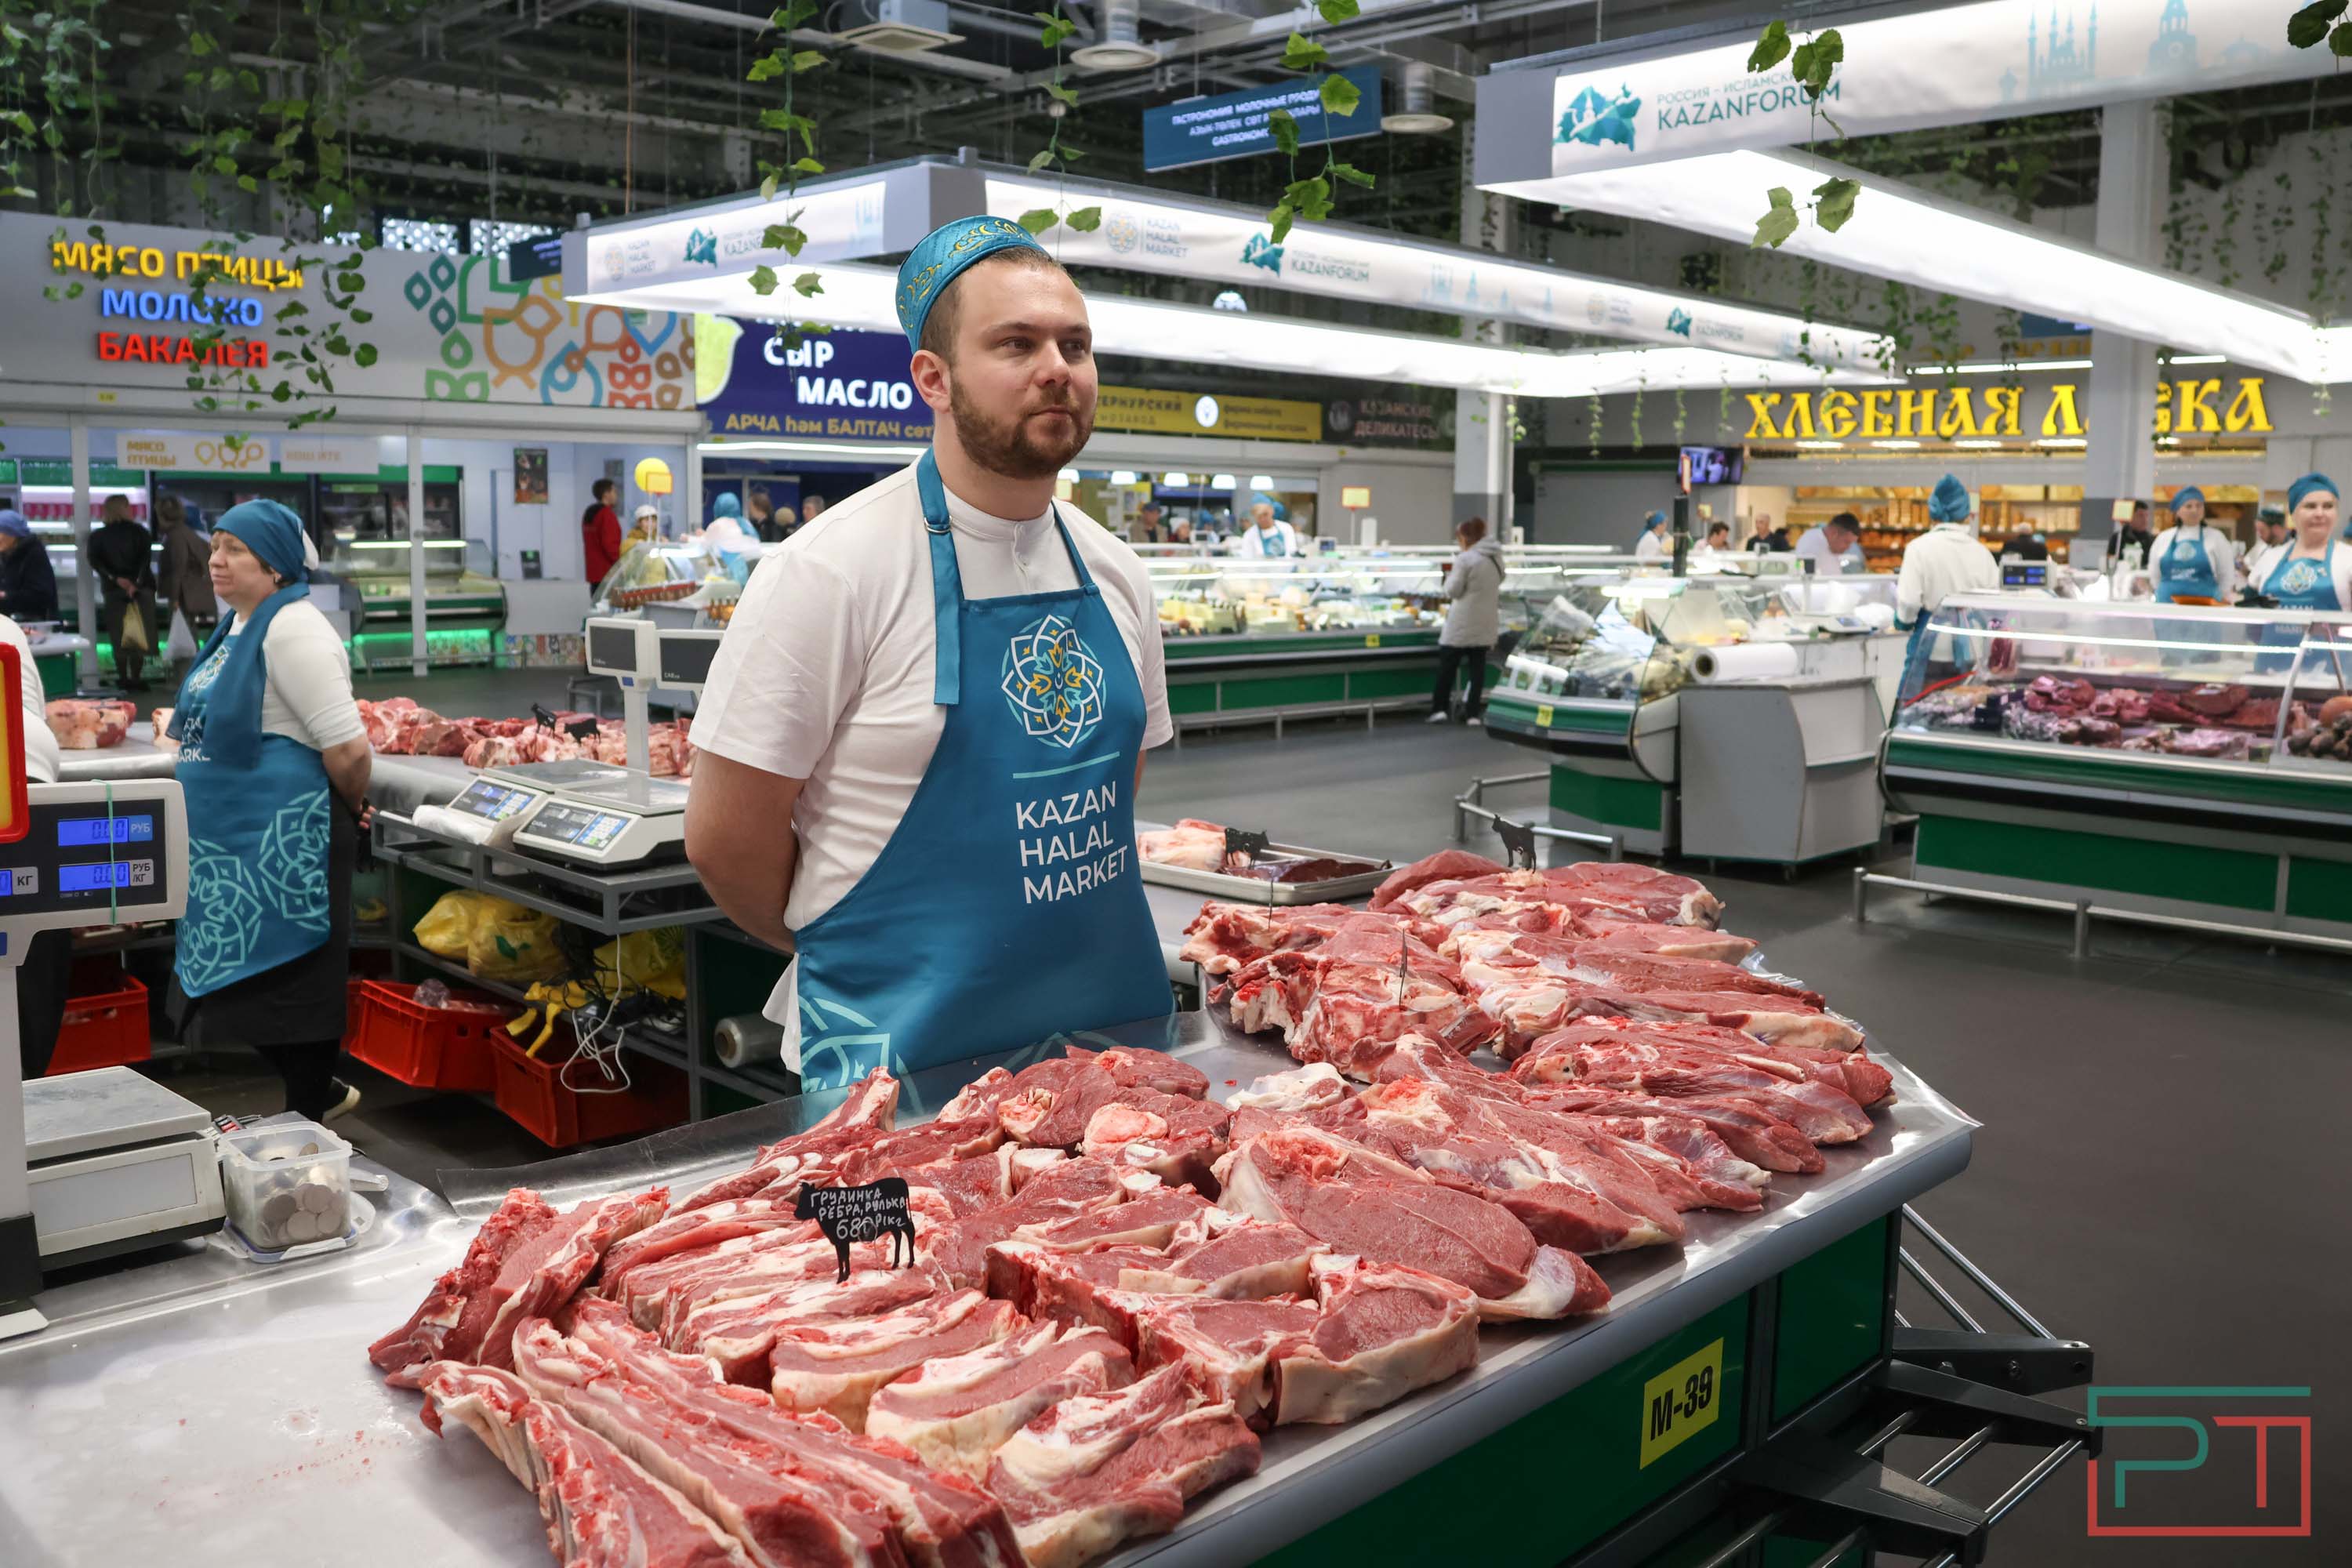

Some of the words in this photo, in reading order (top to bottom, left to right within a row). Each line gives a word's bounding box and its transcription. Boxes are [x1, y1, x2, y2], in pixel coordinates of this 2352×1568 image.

[1657, 86, 1711, 104] РОССИЯ
[1724, 72, 1795, 93] ИСЛАМСК
[1658, 79, 1841, 131] KAZANFORUM
[53, 241, 165, 278] МЯСО
[1292, 260, 1370, 283] KAZANFORUM
[98, 332, 269, 368] БАКАЛЕЯ
[764, 336, 834, 368] СЫР
[797, 376, 913, 410] МАСЛО
[1096, 394, 1182, 412] ЕРНУРСКИЙ
[1744, 385, 2024, 439] ХЛЕБНАЯ
[2041, 376, 2276, 437] ЛКА
[725, 413, 780, 432] АРЧА
[828, 418, 900, 437] БАЛТАЧ
[177, 746, 212, 764] ARK
[1016, 781, 1116, 829] KAZAN
[130, 822, 151, 833] РУБ
[1019, 820, 1114, 868] HALAL
[16, 875, 34, 887] КГ
[132, 862, 151, 872] РУБ
[1023, 846, 1128, 905] MARKET
[810, 1186, 882, 1208] ГРУДИНКА
